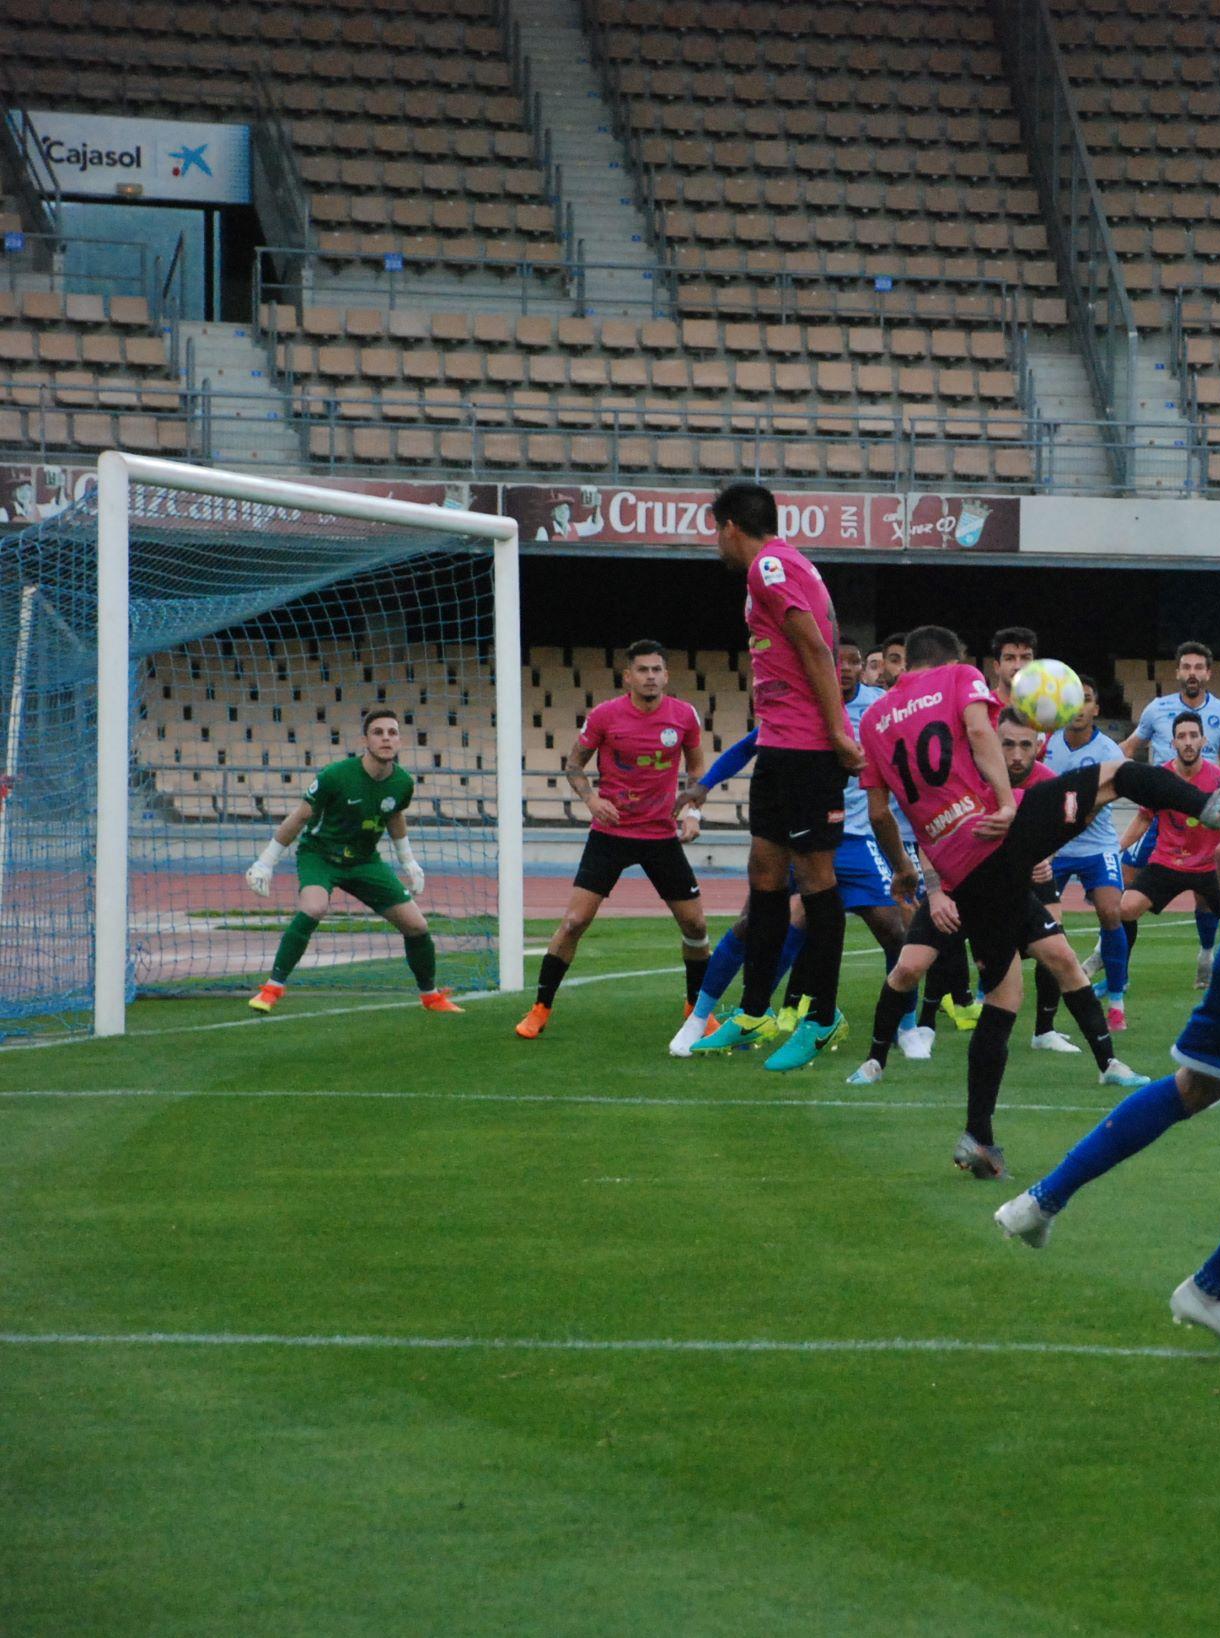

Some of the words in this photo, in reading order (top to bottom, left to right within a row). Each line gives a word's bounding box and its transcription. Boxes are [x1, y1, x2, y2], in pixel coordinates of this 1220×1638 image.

[44, 139, 142, 172] Cajasol
[609, 491, 825, 538] Cruzcpo
[841, 506, 858, 538] SIN
[891, 720, 953, 805] 10
